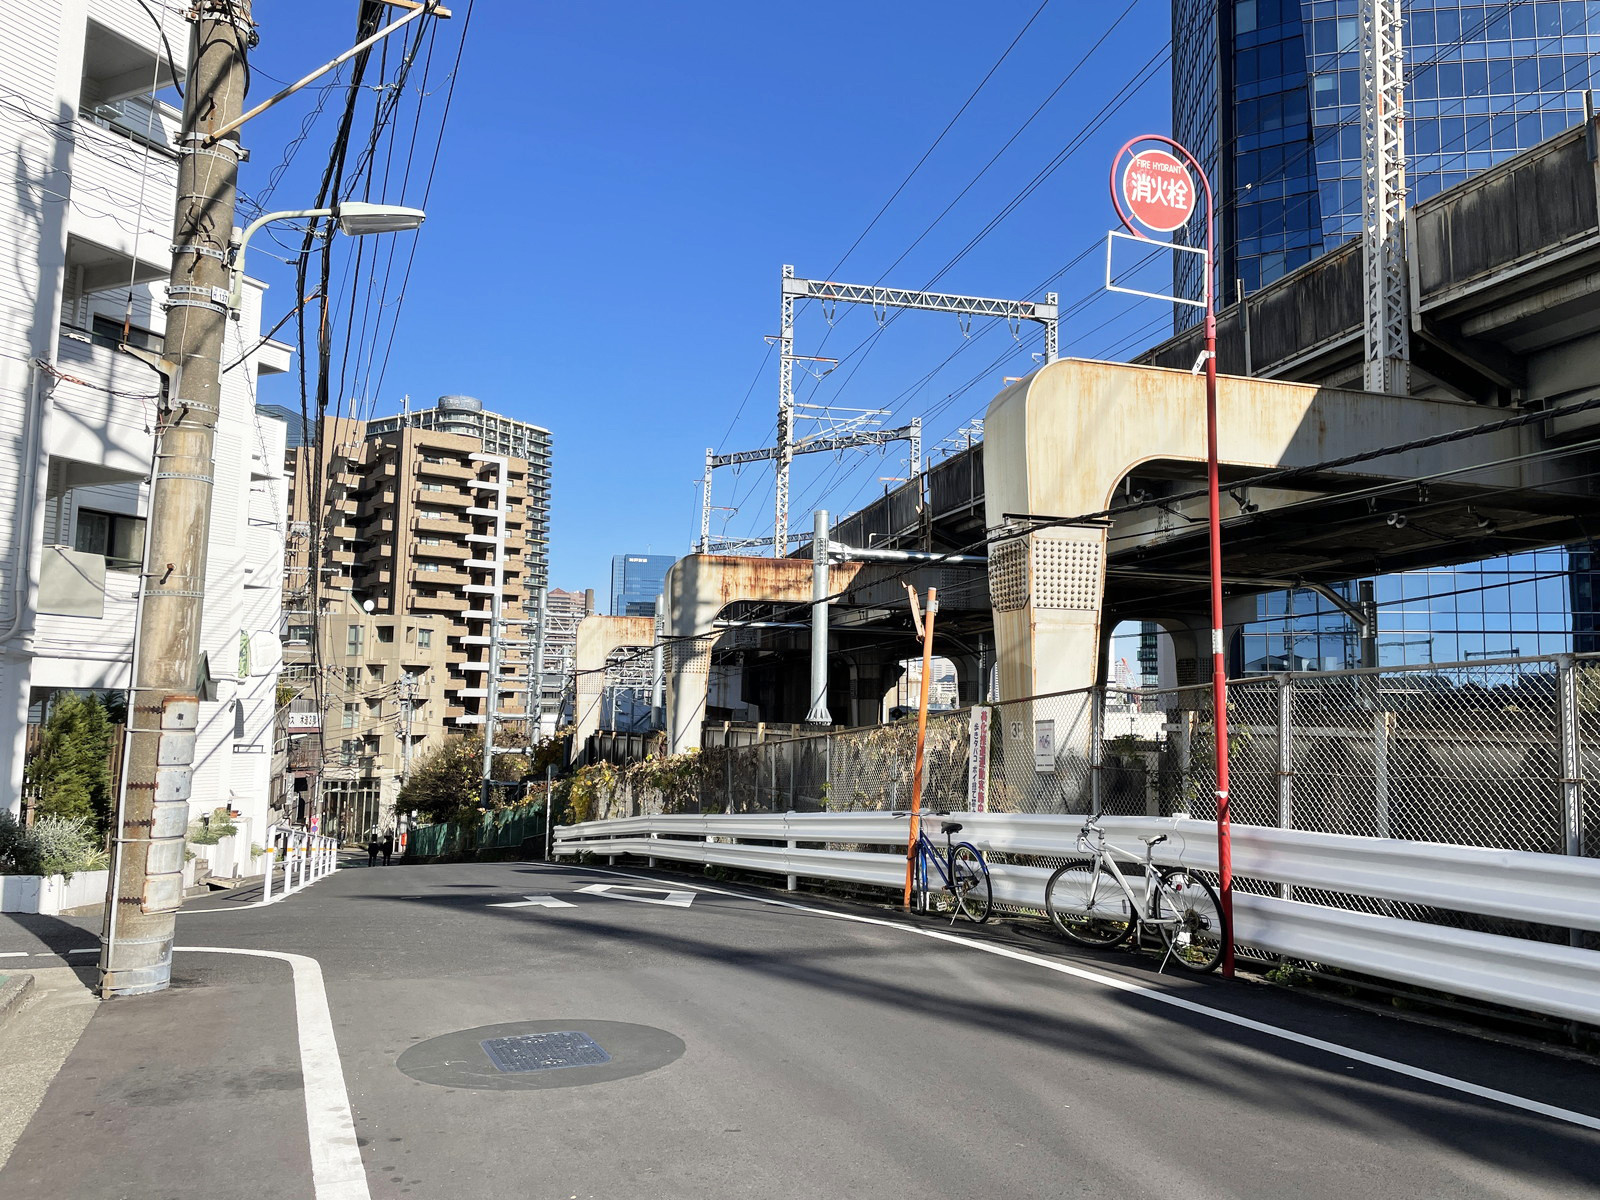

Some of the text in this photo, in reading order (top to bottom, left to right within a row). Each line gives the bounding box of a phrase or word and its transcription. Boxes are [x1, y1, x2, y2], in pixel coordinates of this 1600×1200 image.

[1136, 159, 1182, 174] FIRE HYDRANT
[1131, 171, 1188, 210] 消火栓
